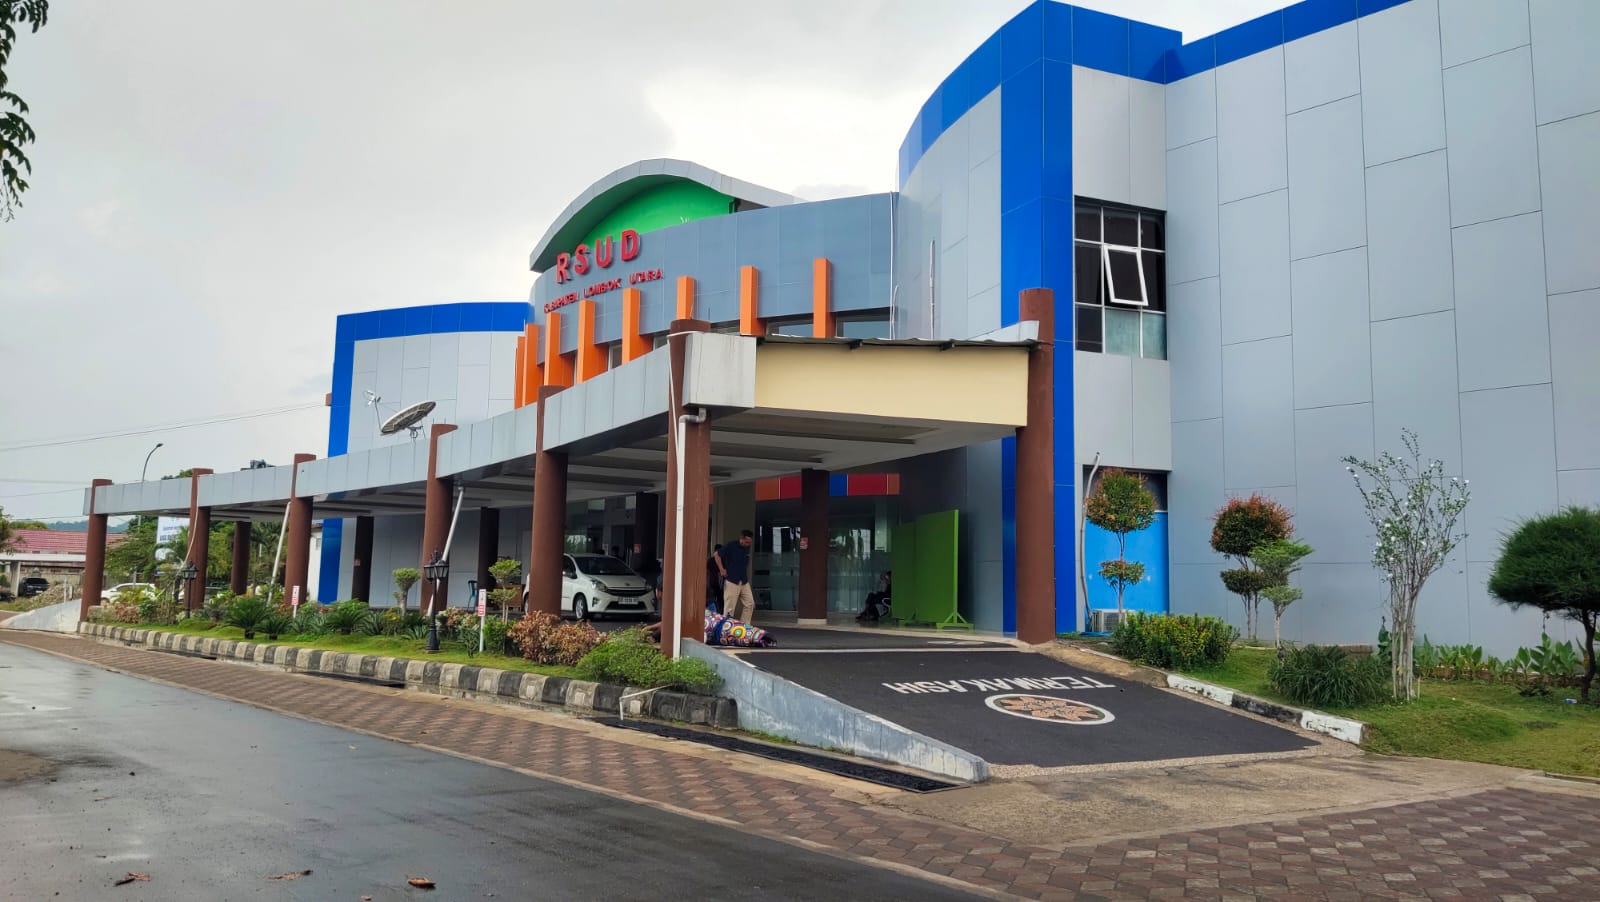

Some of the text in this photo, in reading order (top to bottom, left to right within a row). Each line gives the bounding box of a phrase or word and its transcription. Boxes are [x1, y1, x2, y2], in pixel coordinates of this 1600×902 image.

[556, 231, 639, 283] RSUD
[584, 279, 621, 297] LOMBOK
[630, 269, 662, 284] UTARA
